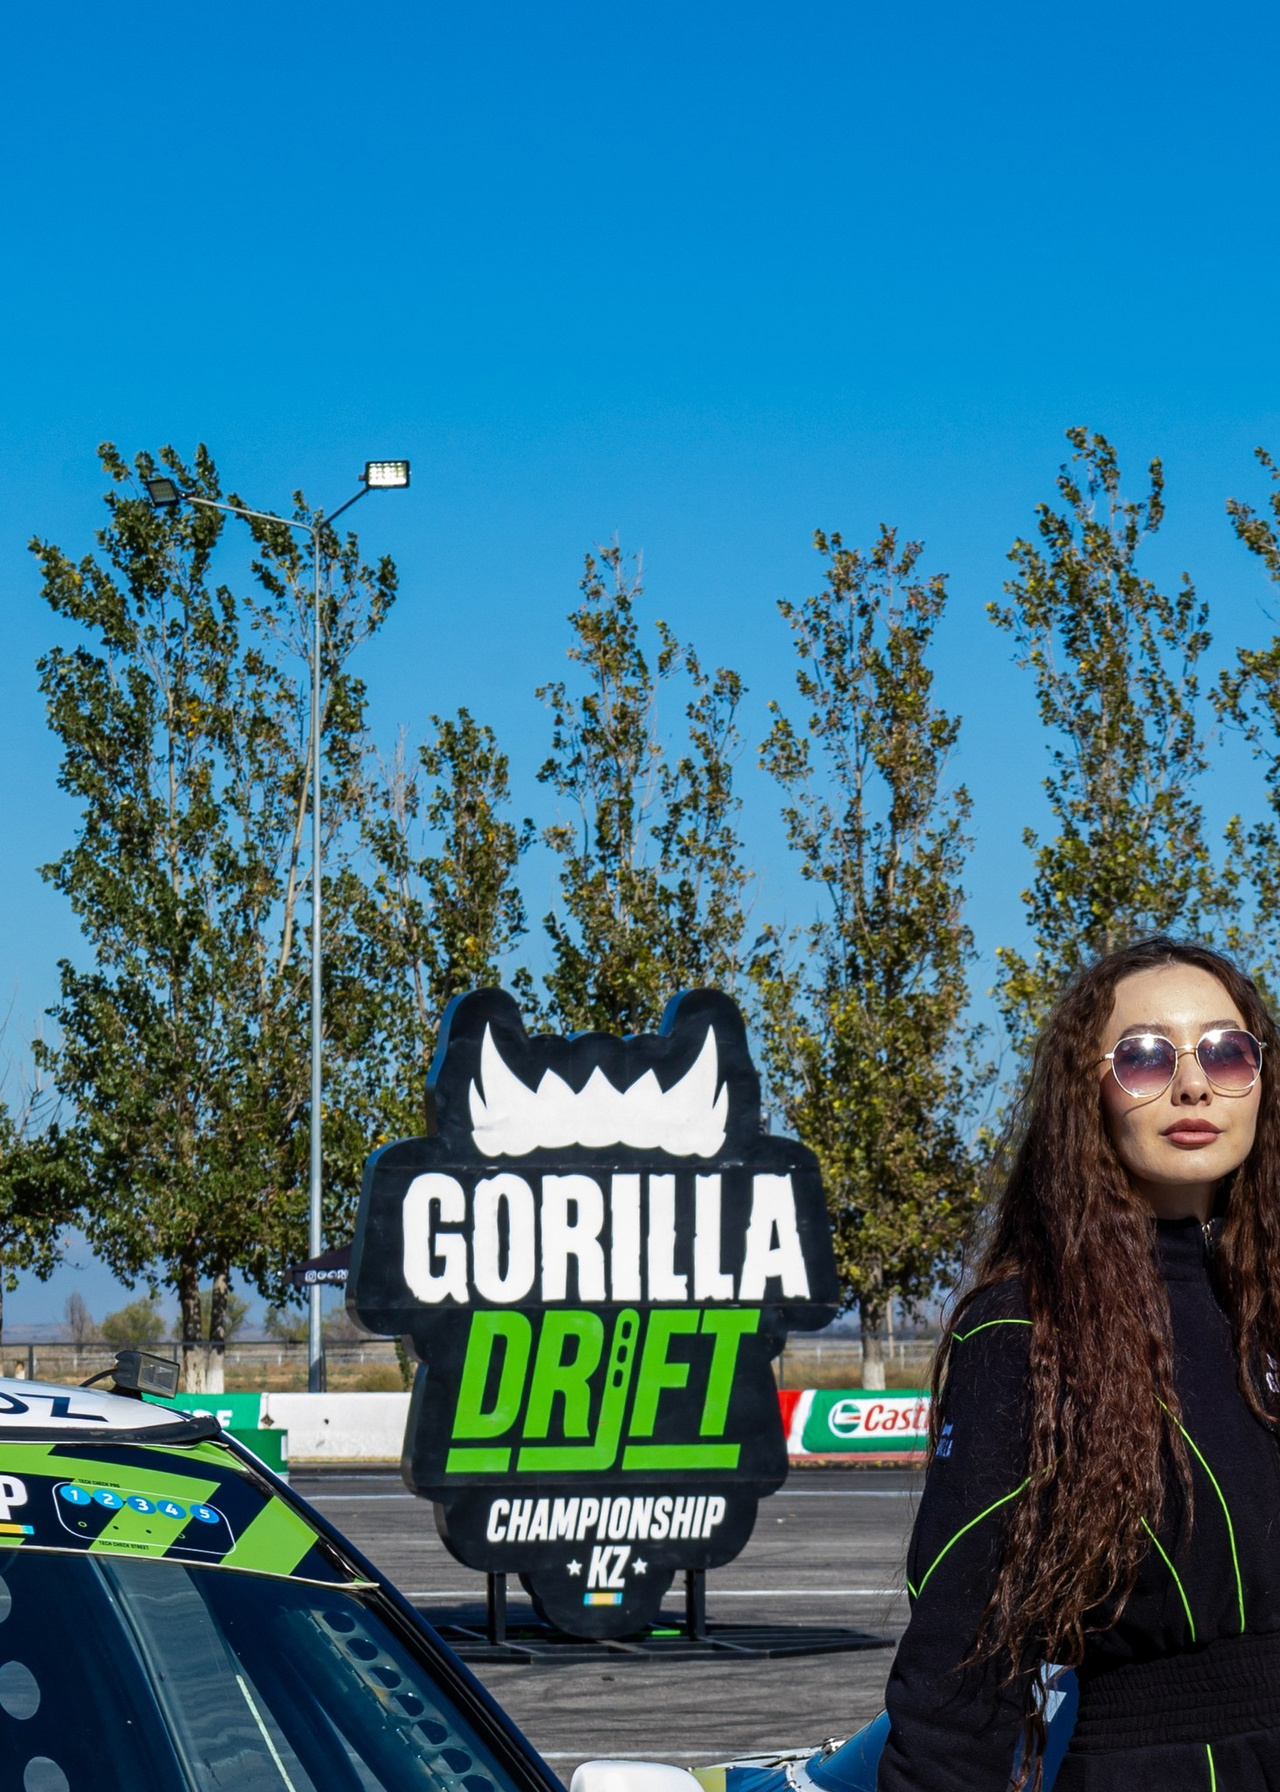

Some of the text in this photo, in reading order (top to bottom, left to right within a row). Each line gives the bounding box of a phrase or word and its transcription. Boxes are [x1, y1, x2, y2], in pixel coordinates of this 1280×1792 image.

[403, 1172, 811, 1303] GORILLA
[445, 1308, 761, 1473] DRIFT
[70, 1490, 210, 1519] 1 2 3 4 5
[486, 1496, 727, 1543] CHAMPIONSHIP
[587, 1546, 632, 1589] KZ
